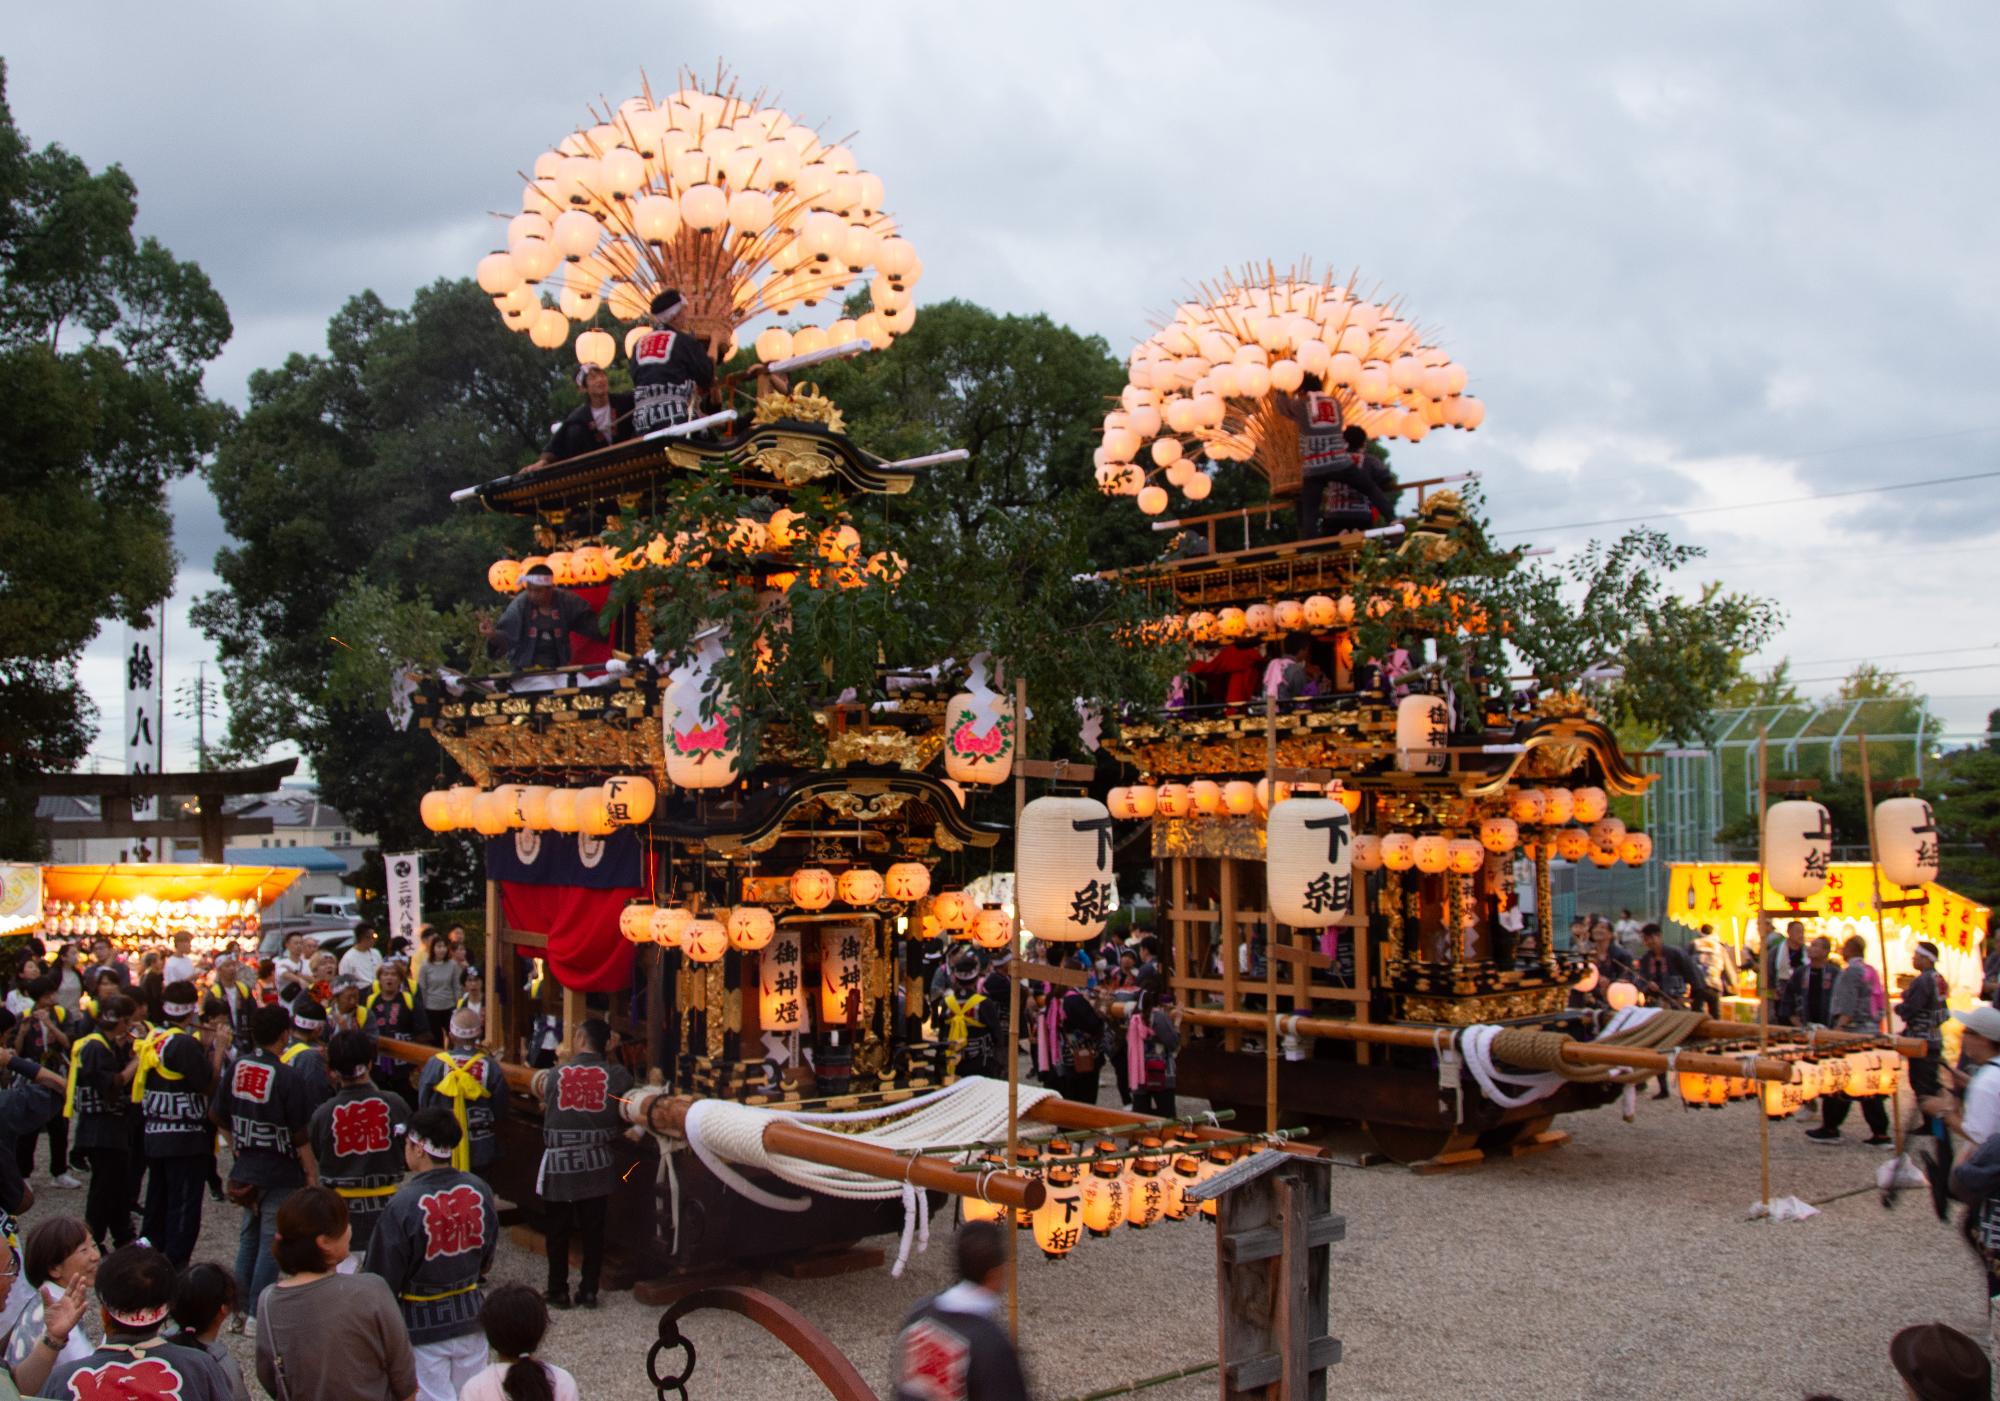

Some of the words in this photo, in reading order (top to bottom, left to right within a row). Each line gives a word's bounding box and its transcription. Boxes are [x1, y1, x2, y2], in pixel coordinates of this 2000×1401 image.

[1302, 813, 1350, 915] 下組
[1802, 808, 1831, 879] 上組
[1911, 804, 1938, 867] 上組
[1069, 817, 1113, 925] 下組
[1709, 870, 1724, 911] ビール
[1828, 872, 1843, 913] お酒
[774, 940, 798, 1024] 御神燈
[1048, 1196, 1080, 1250] 下組
[1144, 1181, 1160, 1222] 保存会
